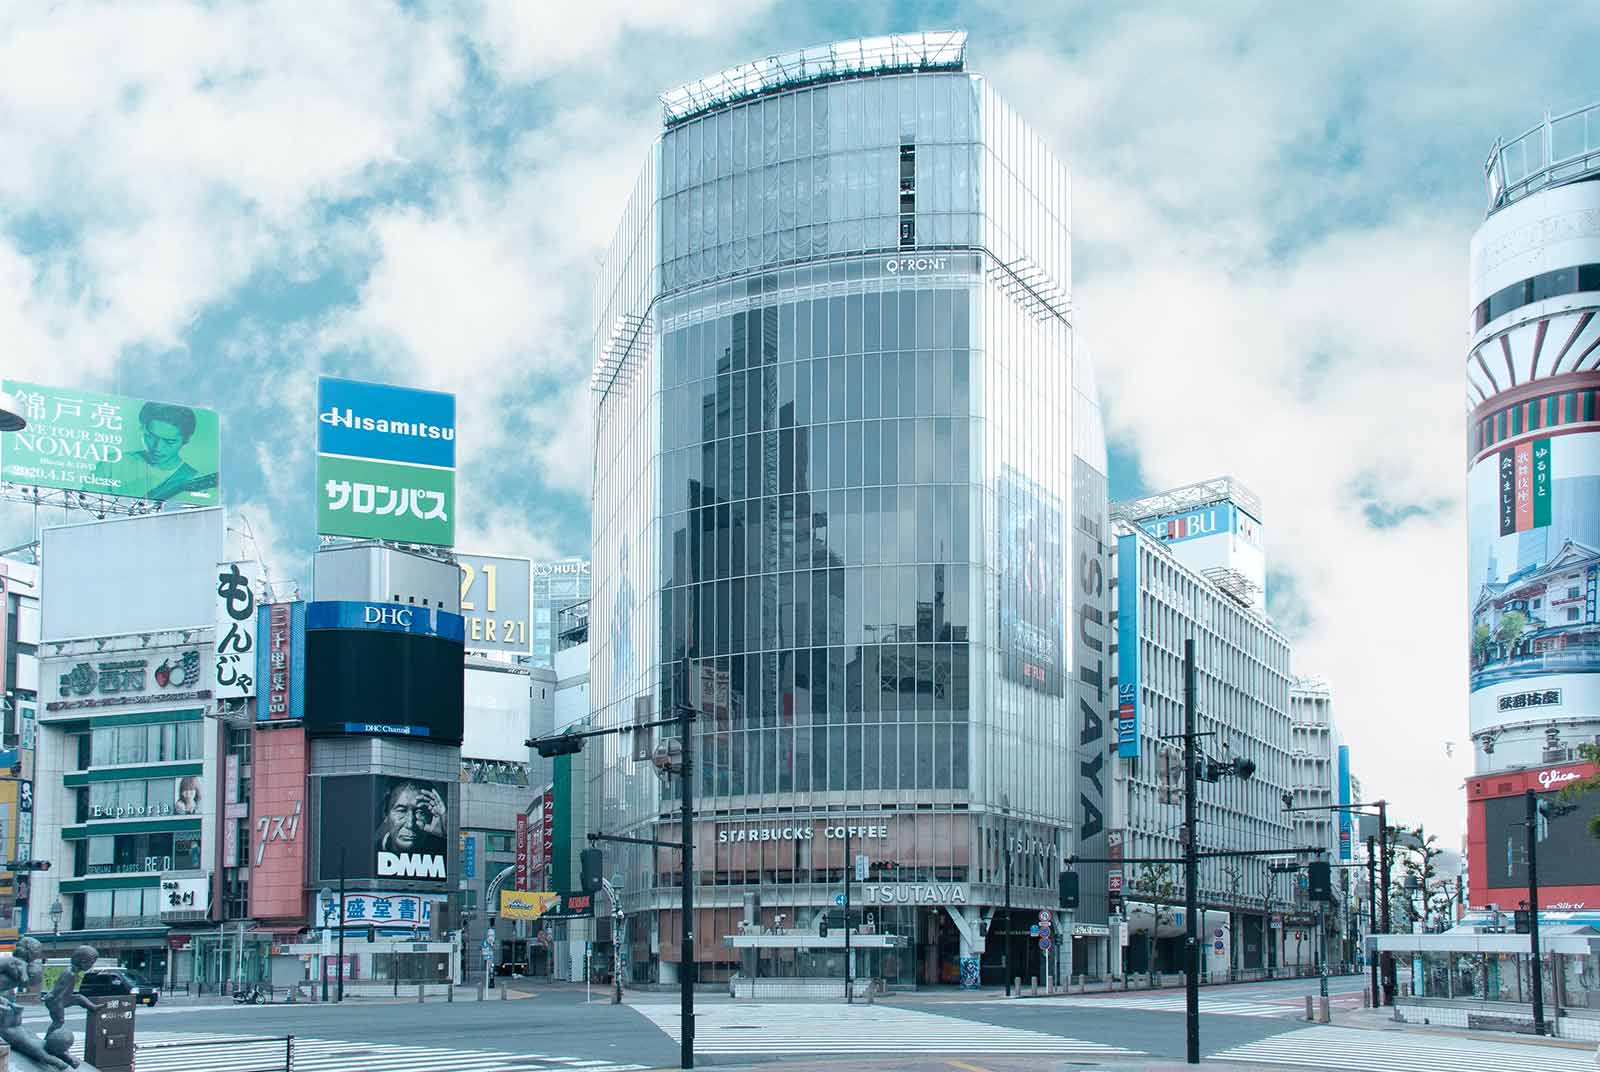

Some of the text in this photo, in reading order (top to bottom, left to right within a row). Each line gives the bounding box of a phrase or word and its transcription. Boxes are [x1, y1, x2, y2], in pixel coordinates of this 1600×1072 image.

[52, 426, 91, 441] TOUR
[94, 431, 123, 445] 2019
[319, 406, 455, 441] Hisamitsu
[13, 431, 123, 463] NOMAD
[80, 473, 122, 488] release
[1535, 447, 1548, 496] ゆるりと
[325, 479, 448, 522] サロンパス
[1502, 457, 1512, 527] 会いましょう
[363, 606, 414, 626] DHC
[216, 563, 255, 695] もんじゃ
[503, 619, 526, 644] 21
[365, 724, 381, 733] DHC
[1537, 770, 1581, 788] Glico
[93, 803, 171, 819] Euphoria
[254, 799, 304, 868] クスリ
[719, 826, 888, 843] STARBUCKS COFFEE
[377, 851, 447, 878] DMM
[866, 885, 967, 904] TSUTAYA
